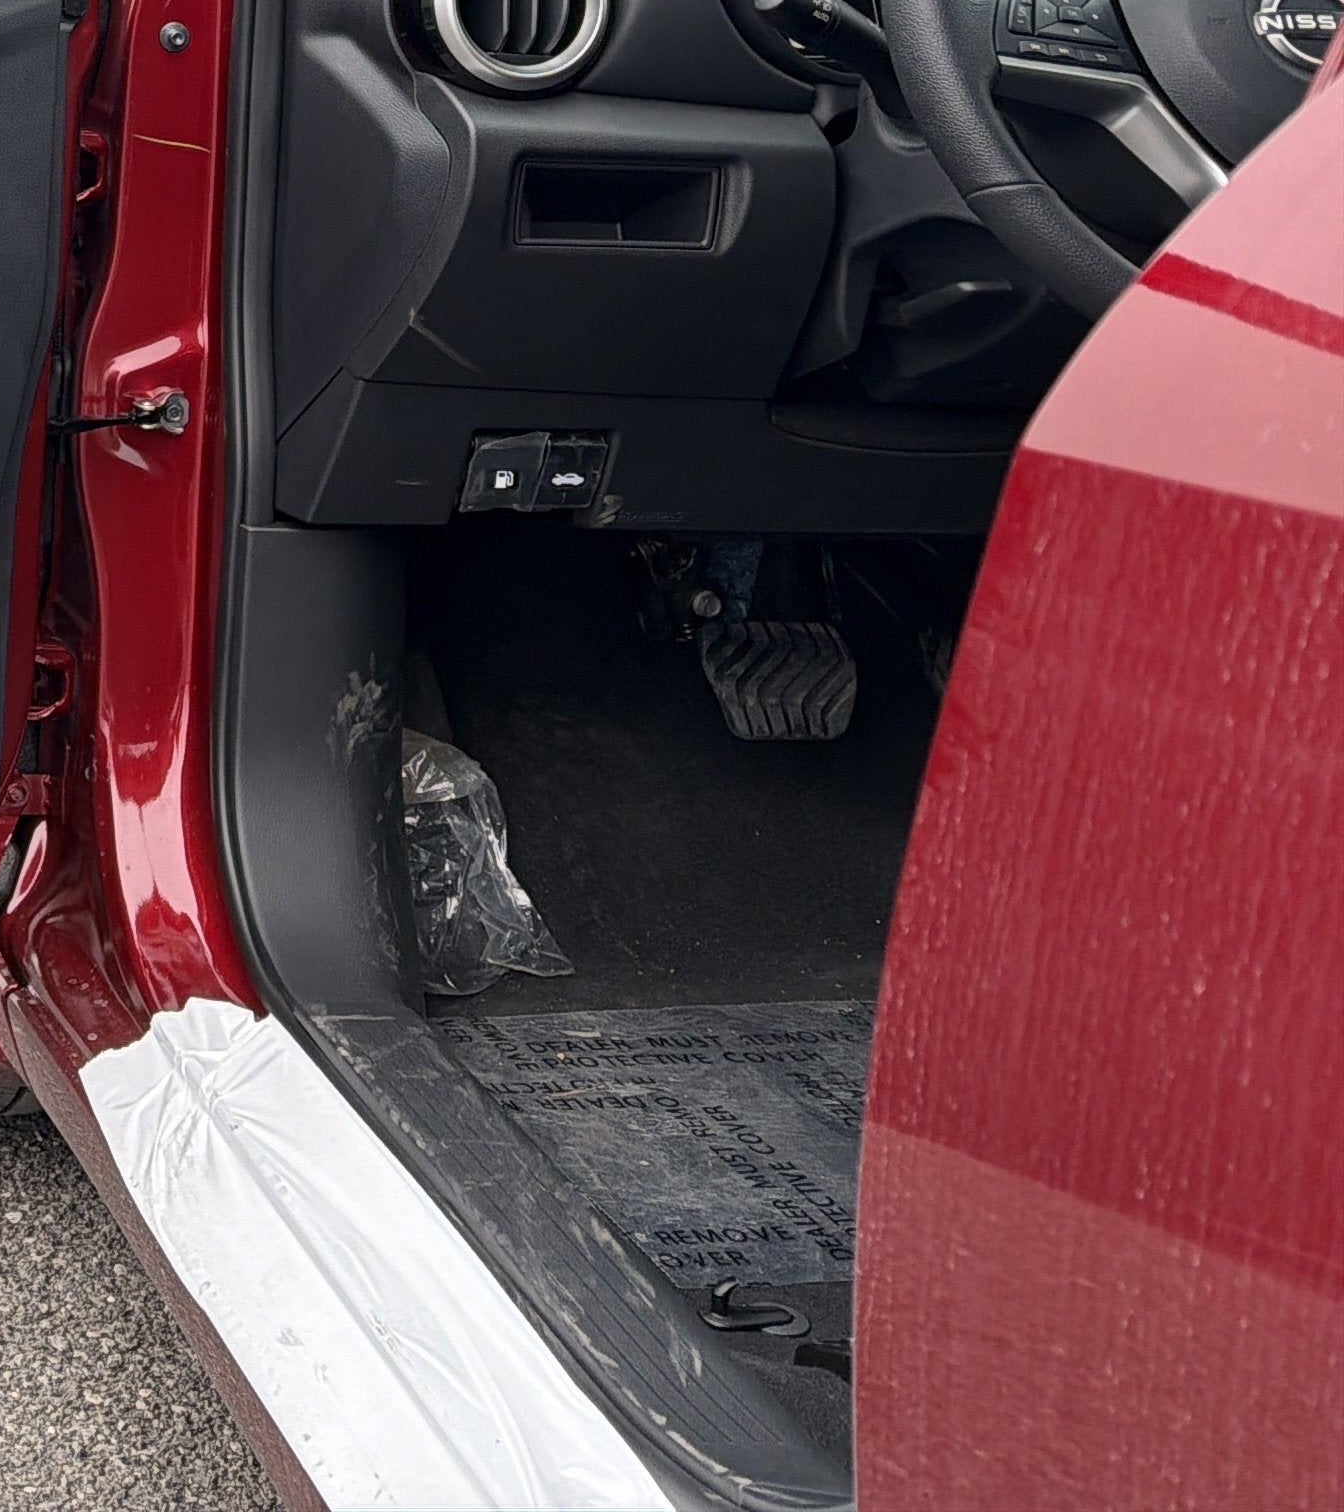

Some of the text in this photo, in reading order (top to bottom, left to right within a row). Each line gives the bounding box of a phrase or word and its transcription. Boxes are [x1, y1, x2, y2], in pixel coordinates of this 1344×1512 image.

[1259, 14, 1337, 31] NISS
[436, 1018, 473, 1044] VER
[525, 1037, 633, 1054] DEALER
[646, 1035, 722, 1048] MUST
[542, 1050, 825, 1071] PROTECTIVE COVER
[535, 1094, 648, 1111] DEALER
[702, 1104, 857, 1238] TECTIVE COVER
[709, 1145, 777, 1189] MUST
[654, 1225, 796, 1246] REMOVE
[772, 1199, 855, 1261] DEALER
[657, 1250, 752, 1269] OVER
